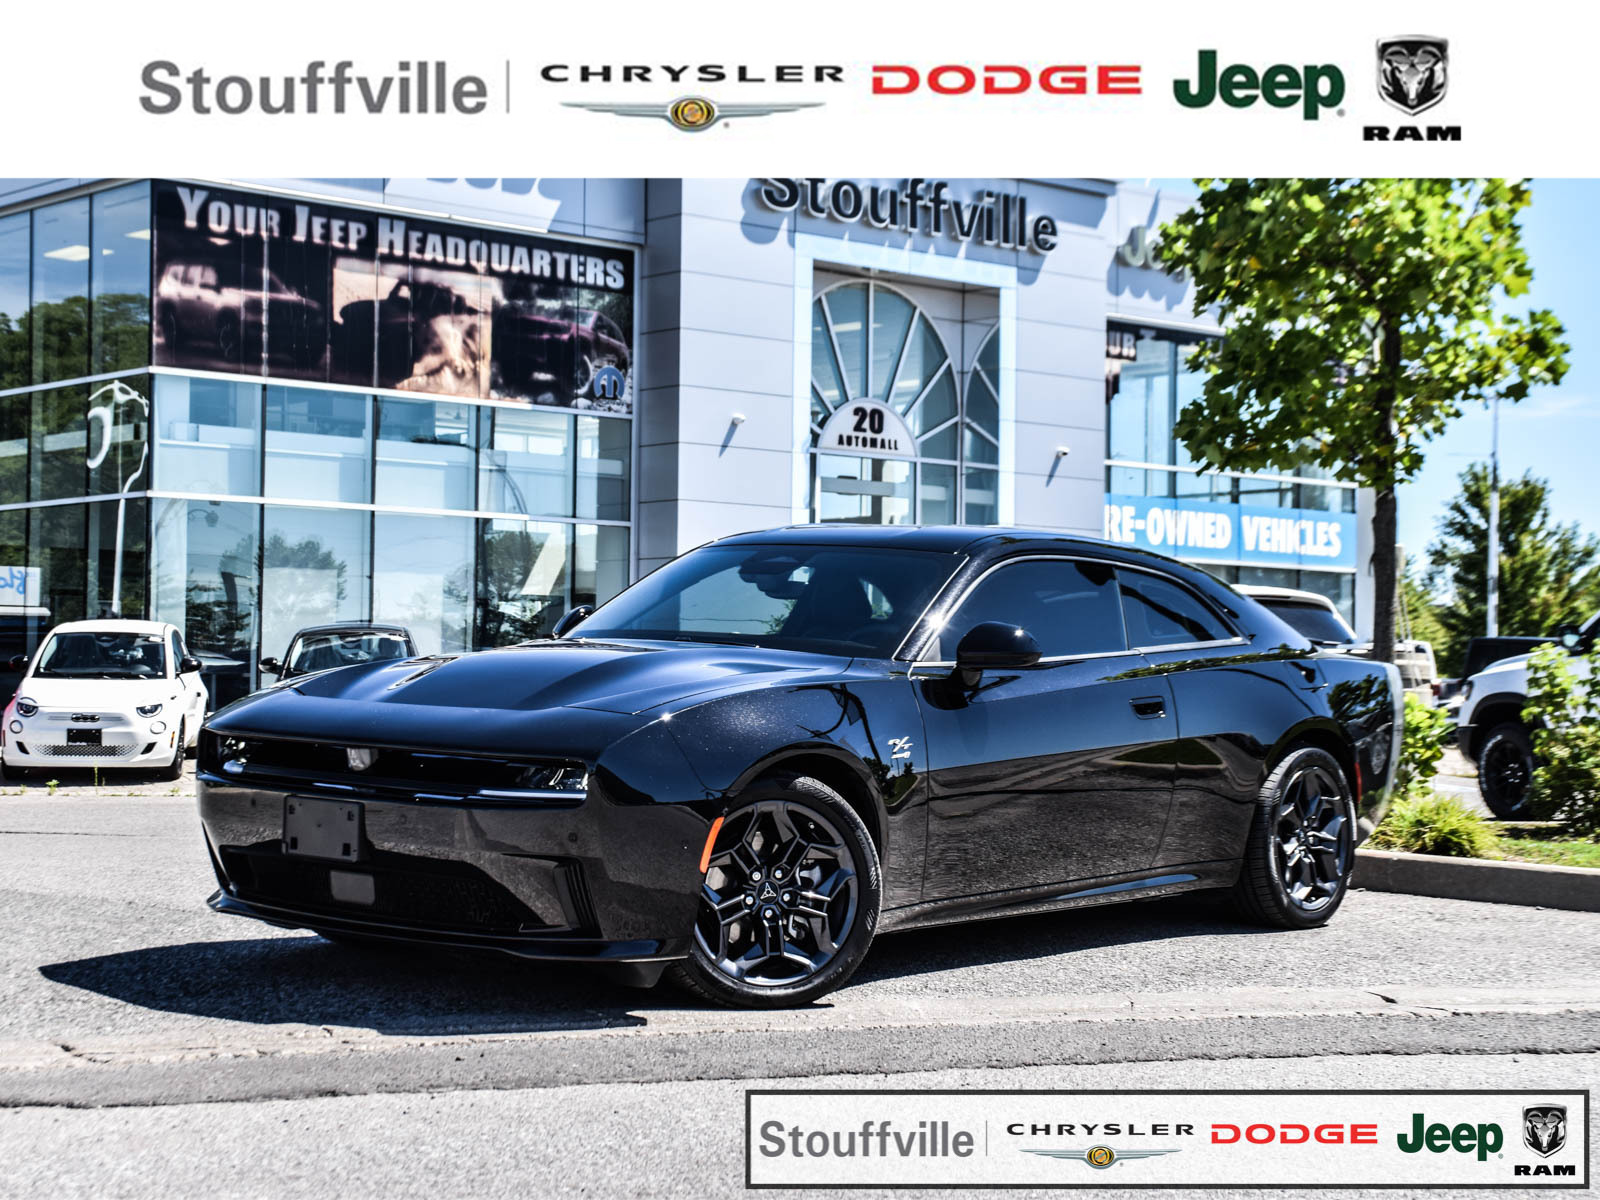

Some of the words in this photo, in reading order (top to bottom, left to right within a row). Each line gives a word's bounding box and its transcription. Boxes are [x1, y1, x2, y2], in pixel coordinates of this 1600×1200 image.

[760, 178, 1058, 254] Stouffville
[852, 406, 885, 435] 20
[837, 434, 899, 451] AUTOMALL
[1241, 515, 1342, 558] VEHICLES
